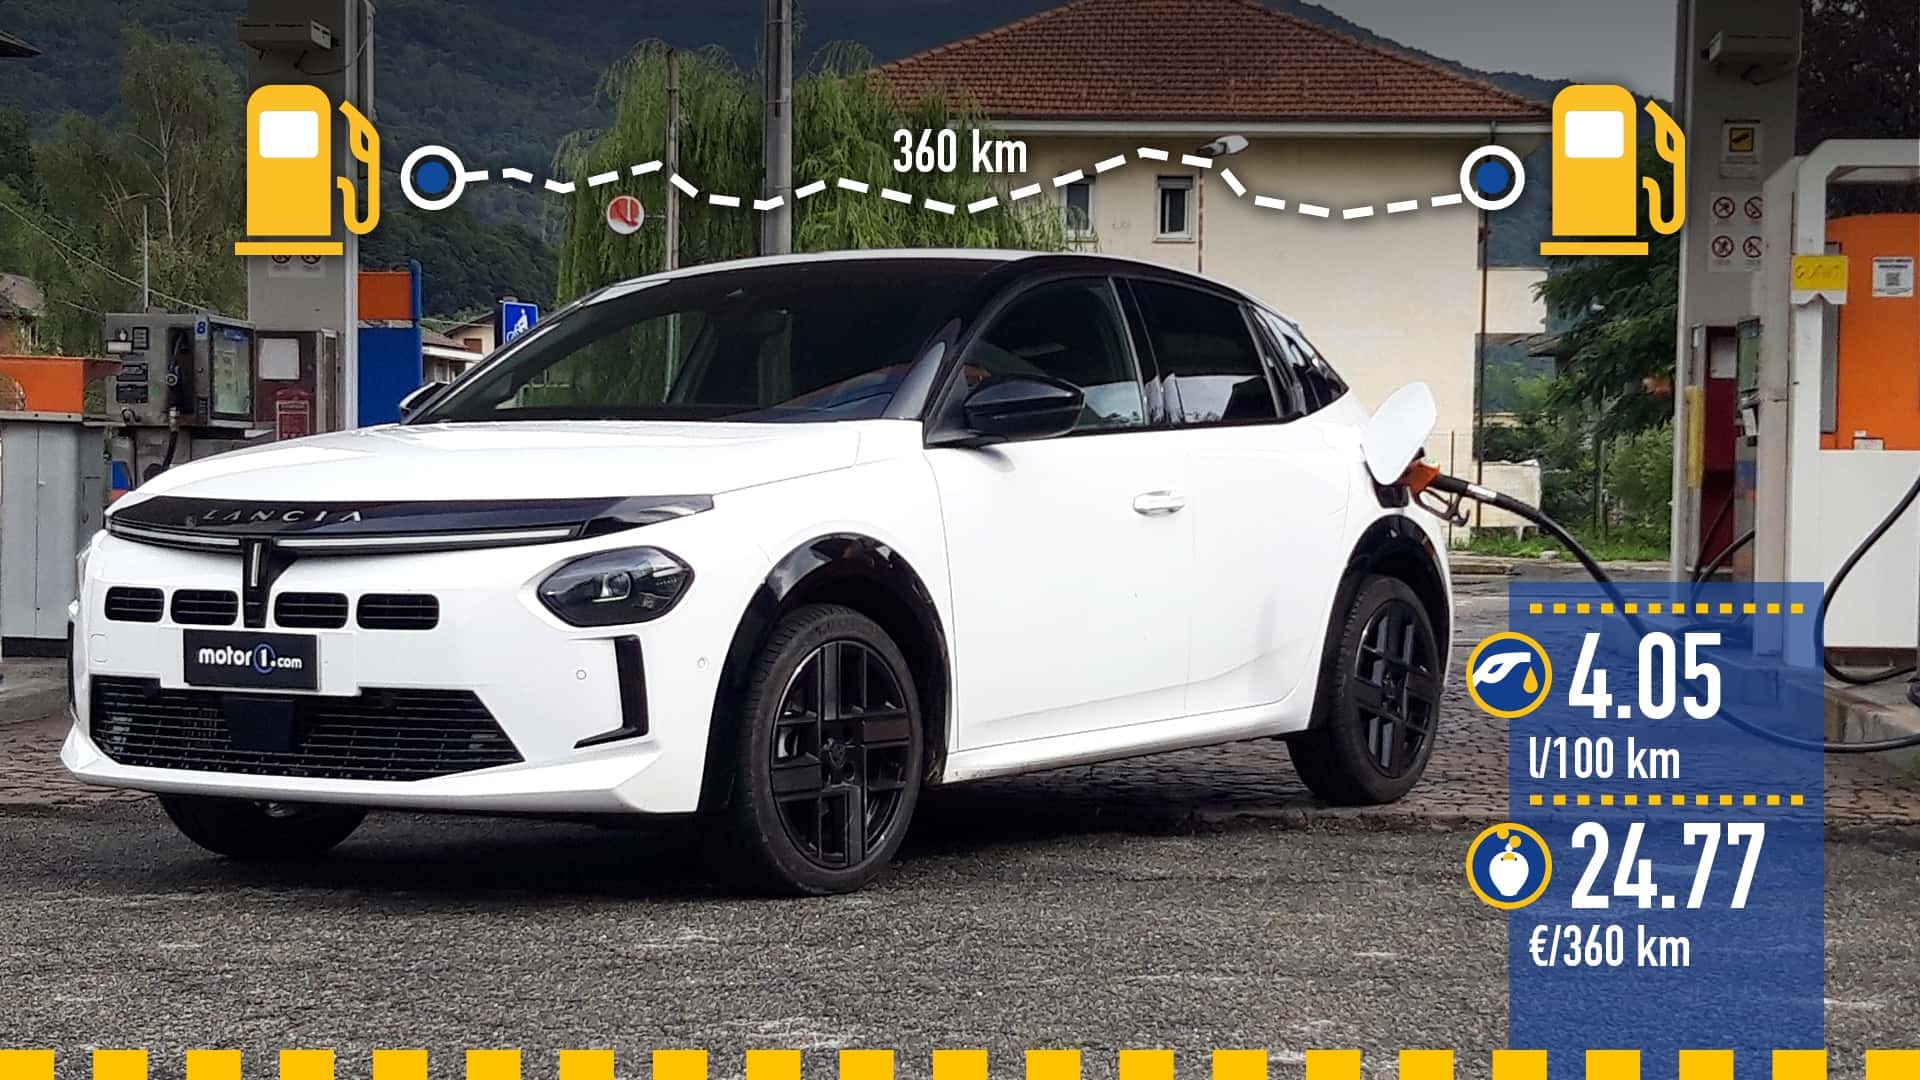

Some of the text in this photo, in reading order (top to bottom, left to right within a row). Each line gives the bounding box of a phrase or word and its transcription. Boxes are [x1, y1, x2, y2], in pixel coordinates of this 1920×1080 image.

[196, 321, 206, 334] 8
[202, 509, 362, 522] LANCIA
[198, 643, 303, 674] motor1.com
